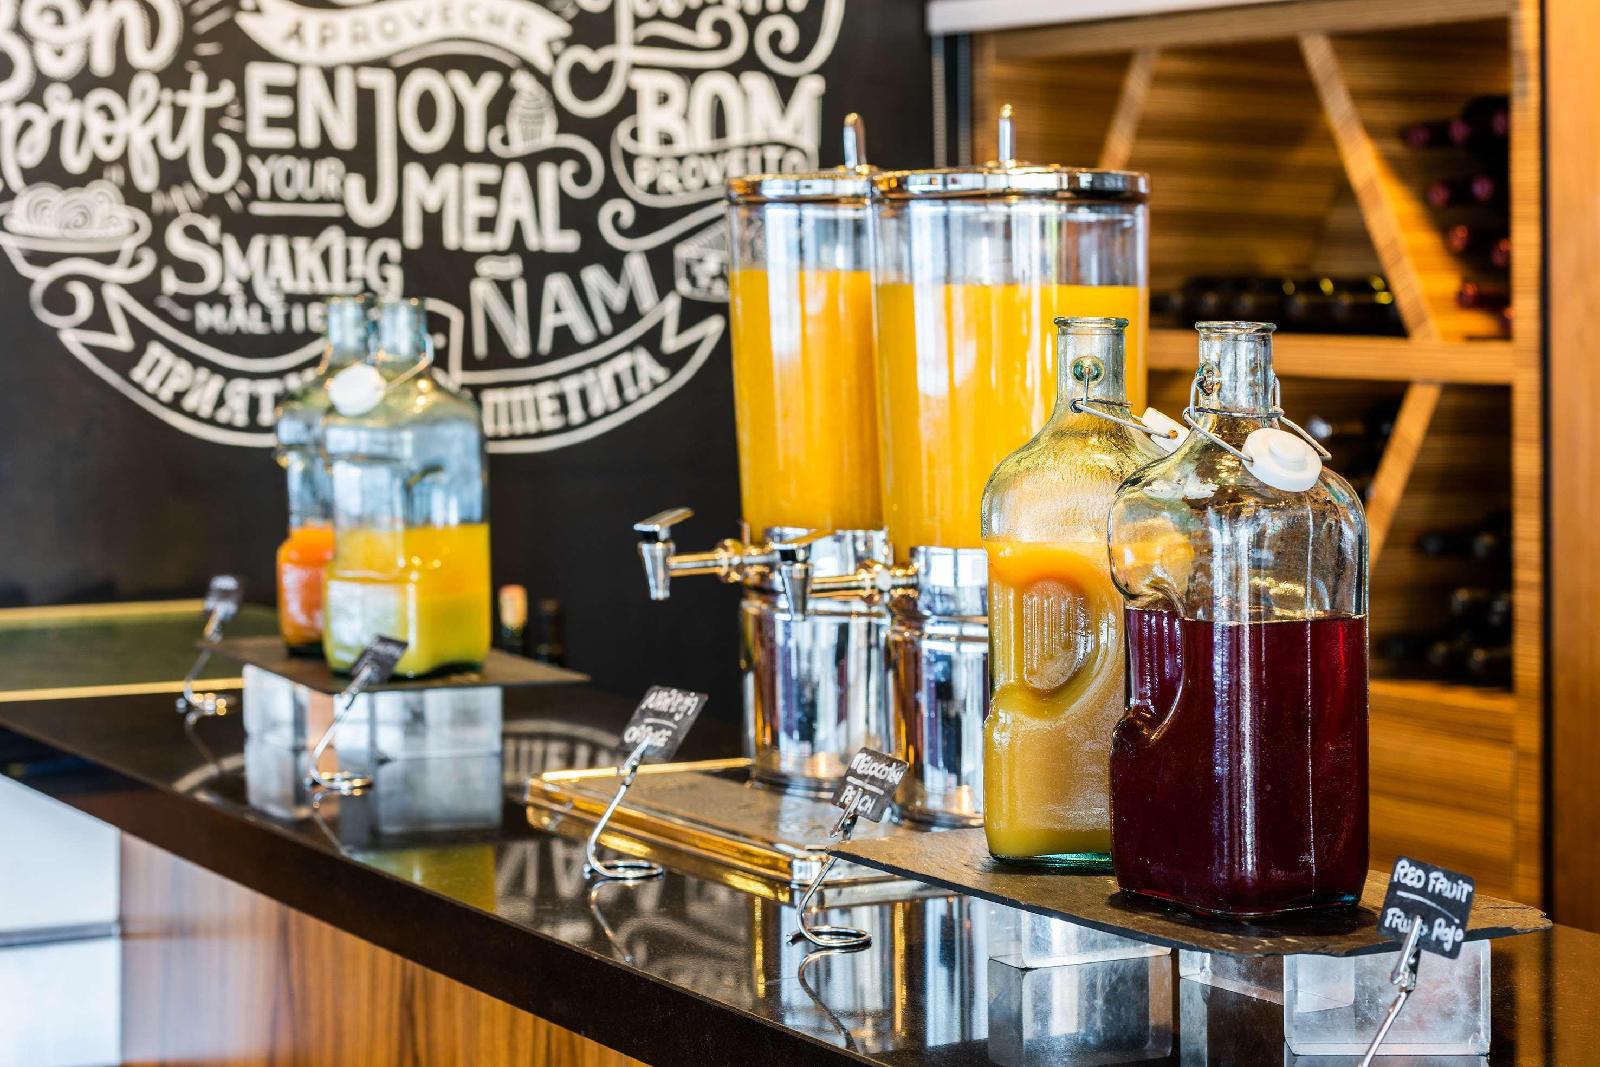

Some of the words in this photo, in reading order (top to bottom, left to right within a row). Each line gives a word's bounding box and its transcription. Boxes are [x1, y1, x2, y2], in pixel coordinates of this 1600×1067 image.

[0, 70, 240, 193] profit
[244, 61, 503, 228] ENJOY
[628, 69, 827, 158] BOM
[247, 154, 346, 200] YOUR
[401, 161, 582, 253] MEAL
[469, 253, 660, 360] ÑAM
[1393, 859, 1427, 889] RED
